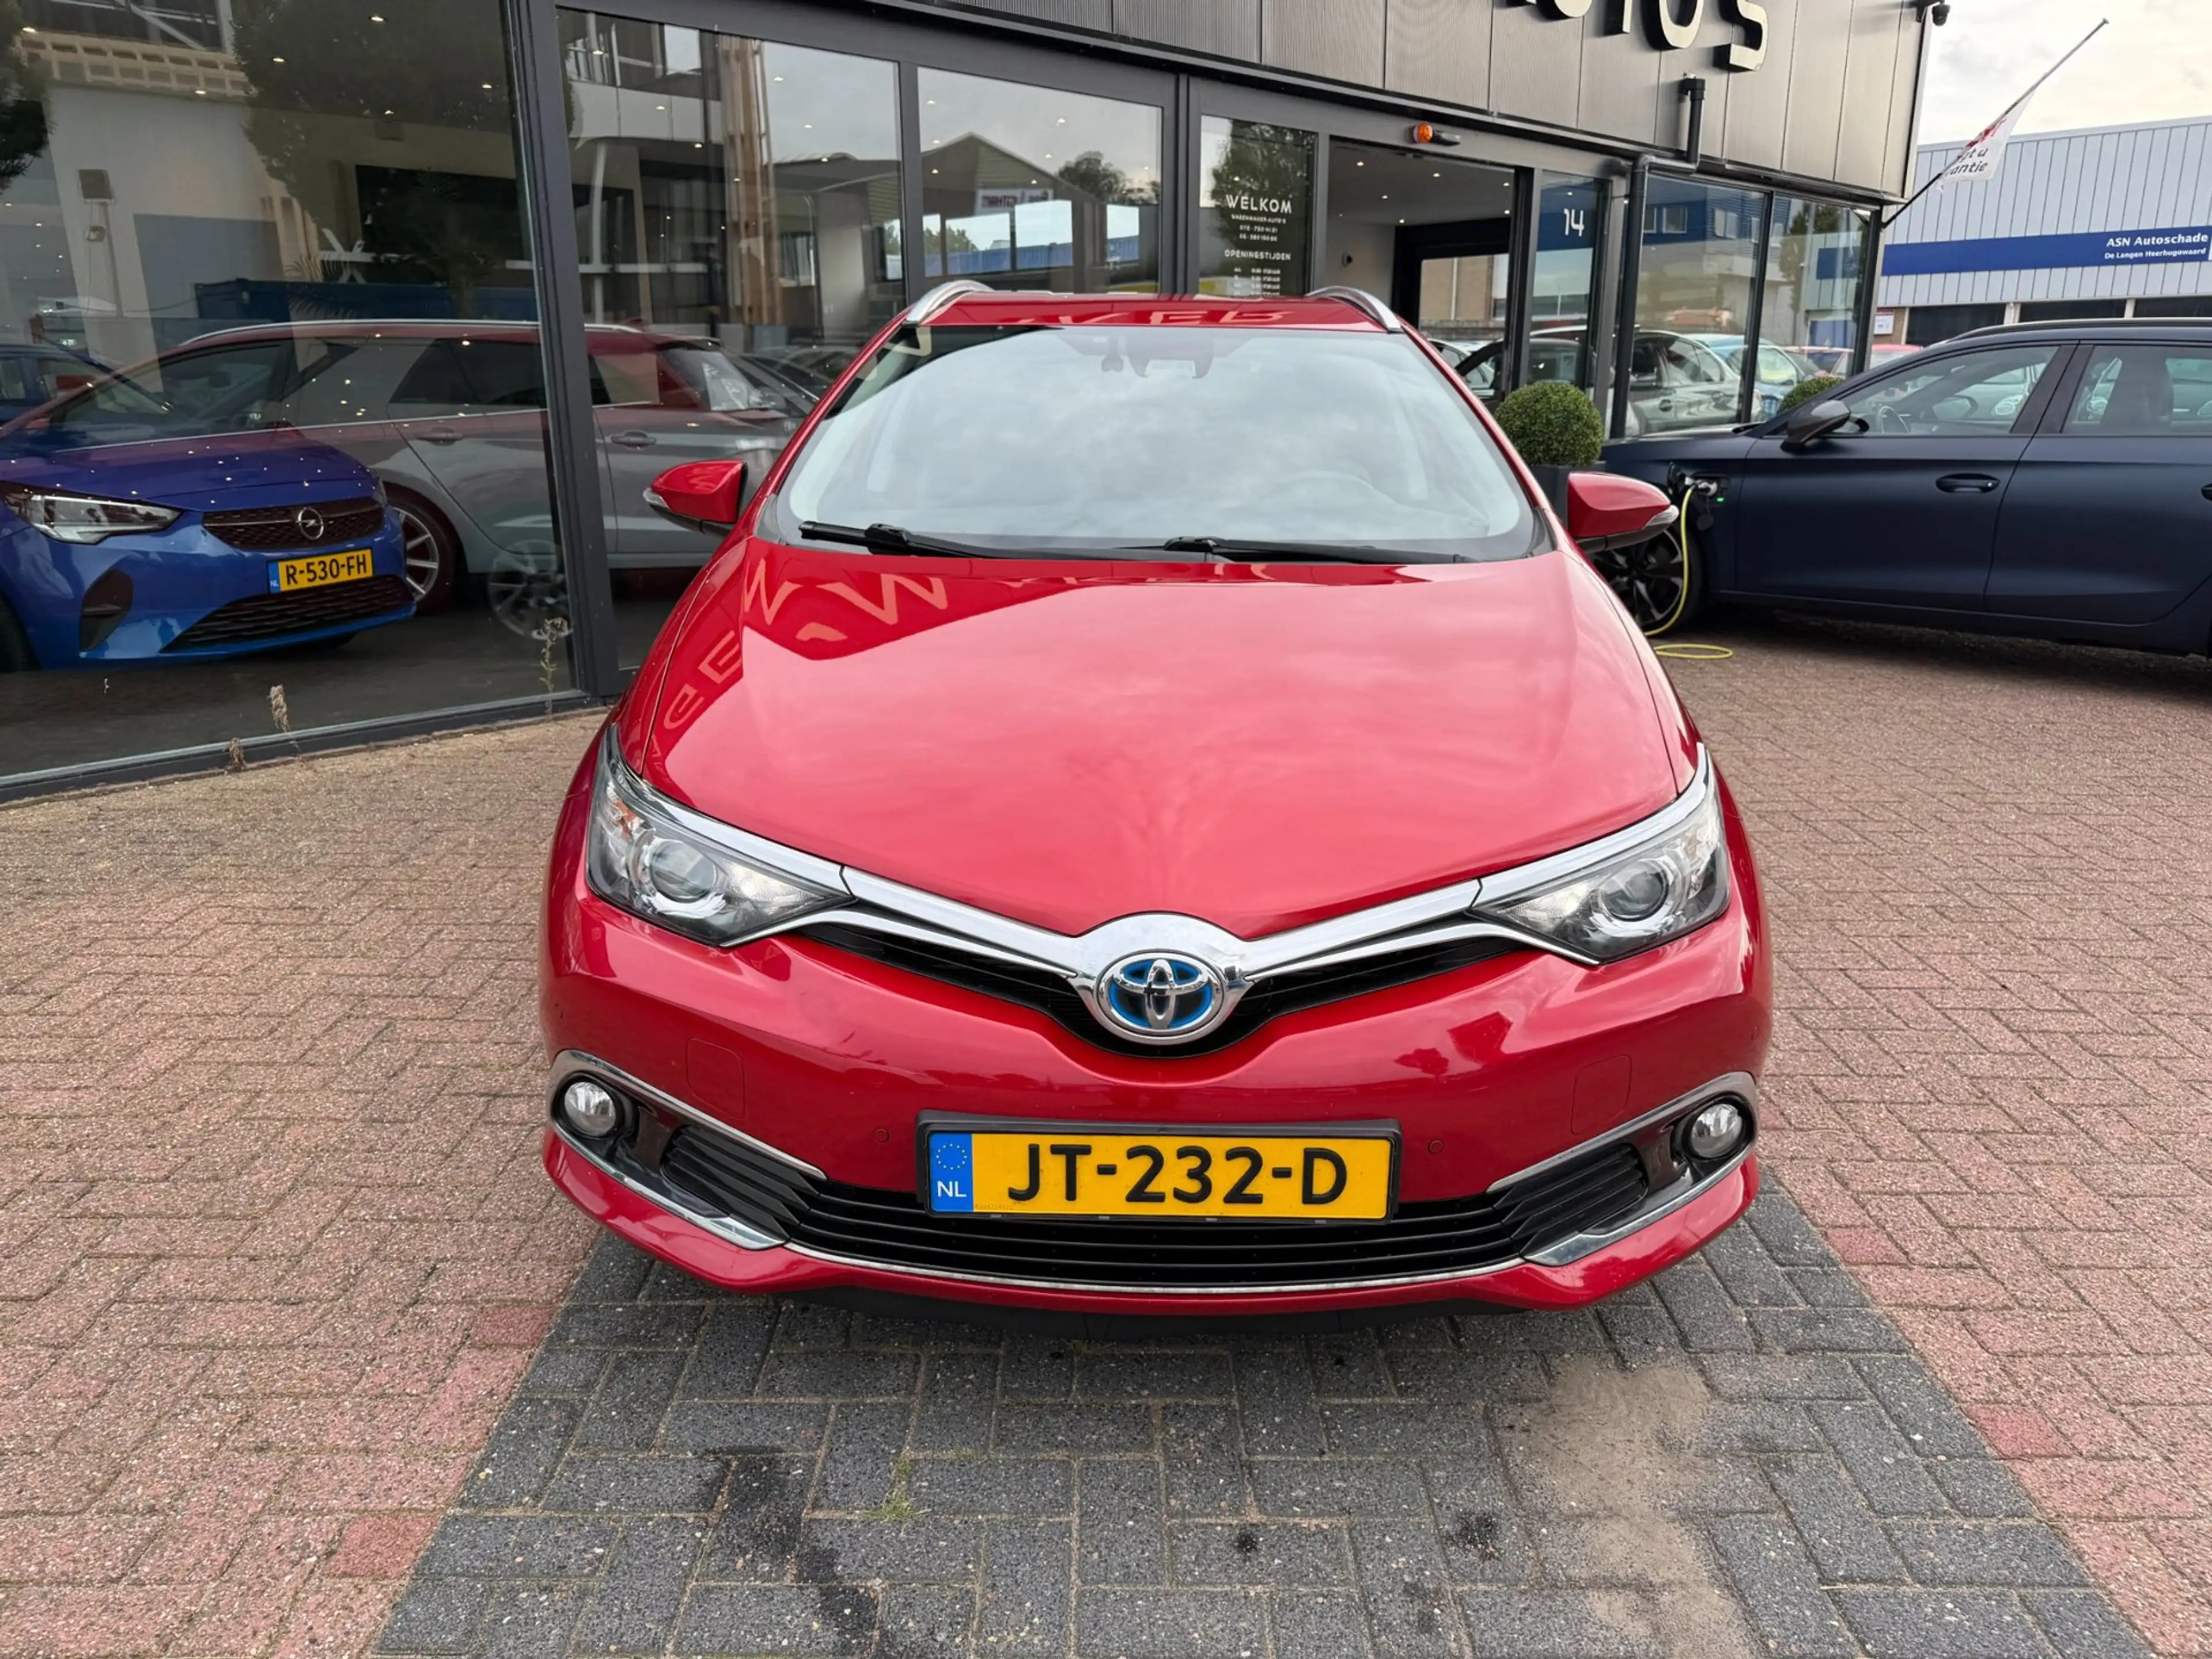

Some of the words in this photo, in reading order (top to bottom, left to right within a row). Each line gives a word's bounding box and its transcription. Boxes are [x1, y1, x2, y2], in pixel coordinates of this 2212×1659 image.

[1226, 194, 1291, 214] WELKOM
[1563, 208, 1585, 237] 14
[2107, 237, 2131, 247] ASN
[2134, 232, 2209, 245] Autoschade
[1224, 249, 1291, 260] OPENINGSTIJDEN
[286, 554, 366, 585] R-530-FH
[1008, 1143, 1347, 1205] JT-232-D
[937, 1180, 967, 1198] NL
